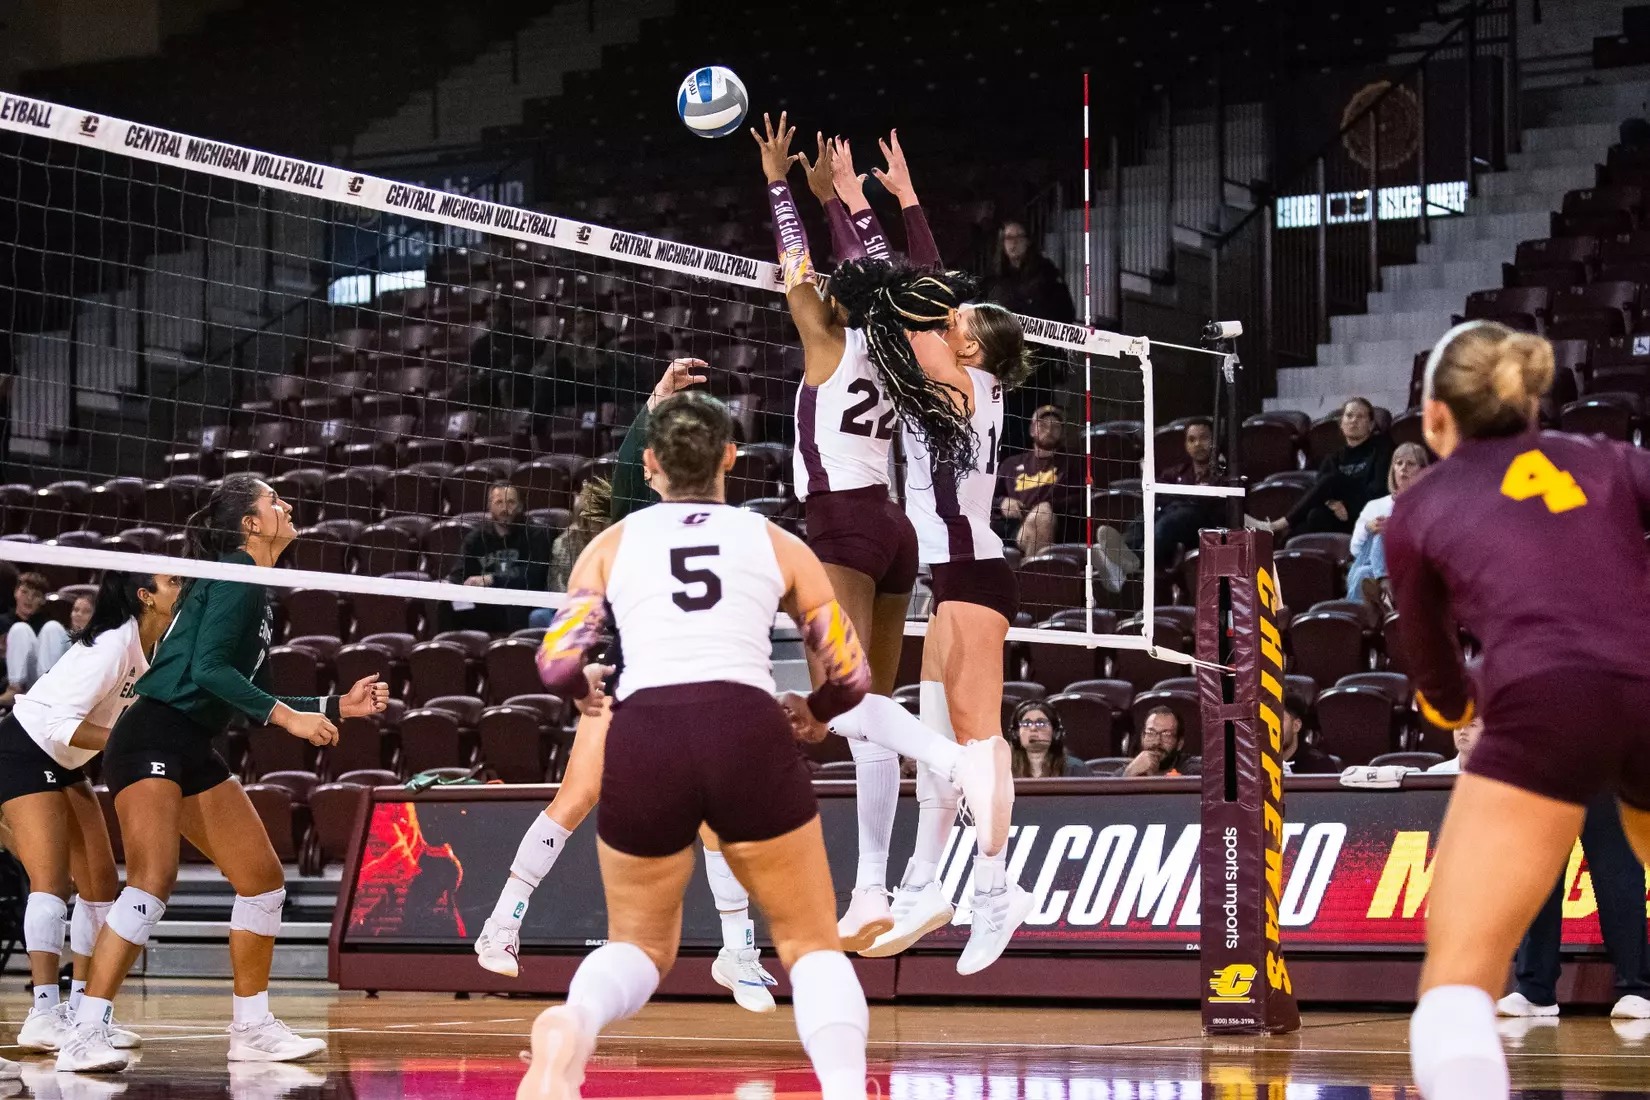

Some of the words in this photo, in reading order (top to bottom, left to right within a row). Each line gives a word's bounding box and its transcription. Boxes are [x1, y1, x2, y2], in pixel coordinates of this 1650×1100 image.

[0, 97, 52, 128] EYBALL
[124, 125, 181, 159] CENTRAL
[184, 140, 250, 173] MICHIGAN
[251, 152, 324, 190] VOLLEYBALL
[385, 184, 436, 214] CENTRAL
[438, 194, 495, 226] MICHIGAN
[494, 206, 558, 239] VOLLEYBALL
[774, 200, 805, 258] CHIPPEWAS
[609, 232, 653, 260] CENTRAL
[654, 241, 703, 269] MICHIGAN
[704, 251, 759, 281] VOLLEYBALL
[1044, 318, 1088, 346] VOLLEYBALL
[985, 420, 1001, 475] 1
[1500, 449, 1588, 514] 4
[669, 545, 722, 612] 5
[150, 761, 166, 776] E
[1256, 566, 1292, 996] CHIPPEWAS
[1222, 826, 1240, 880] sports
